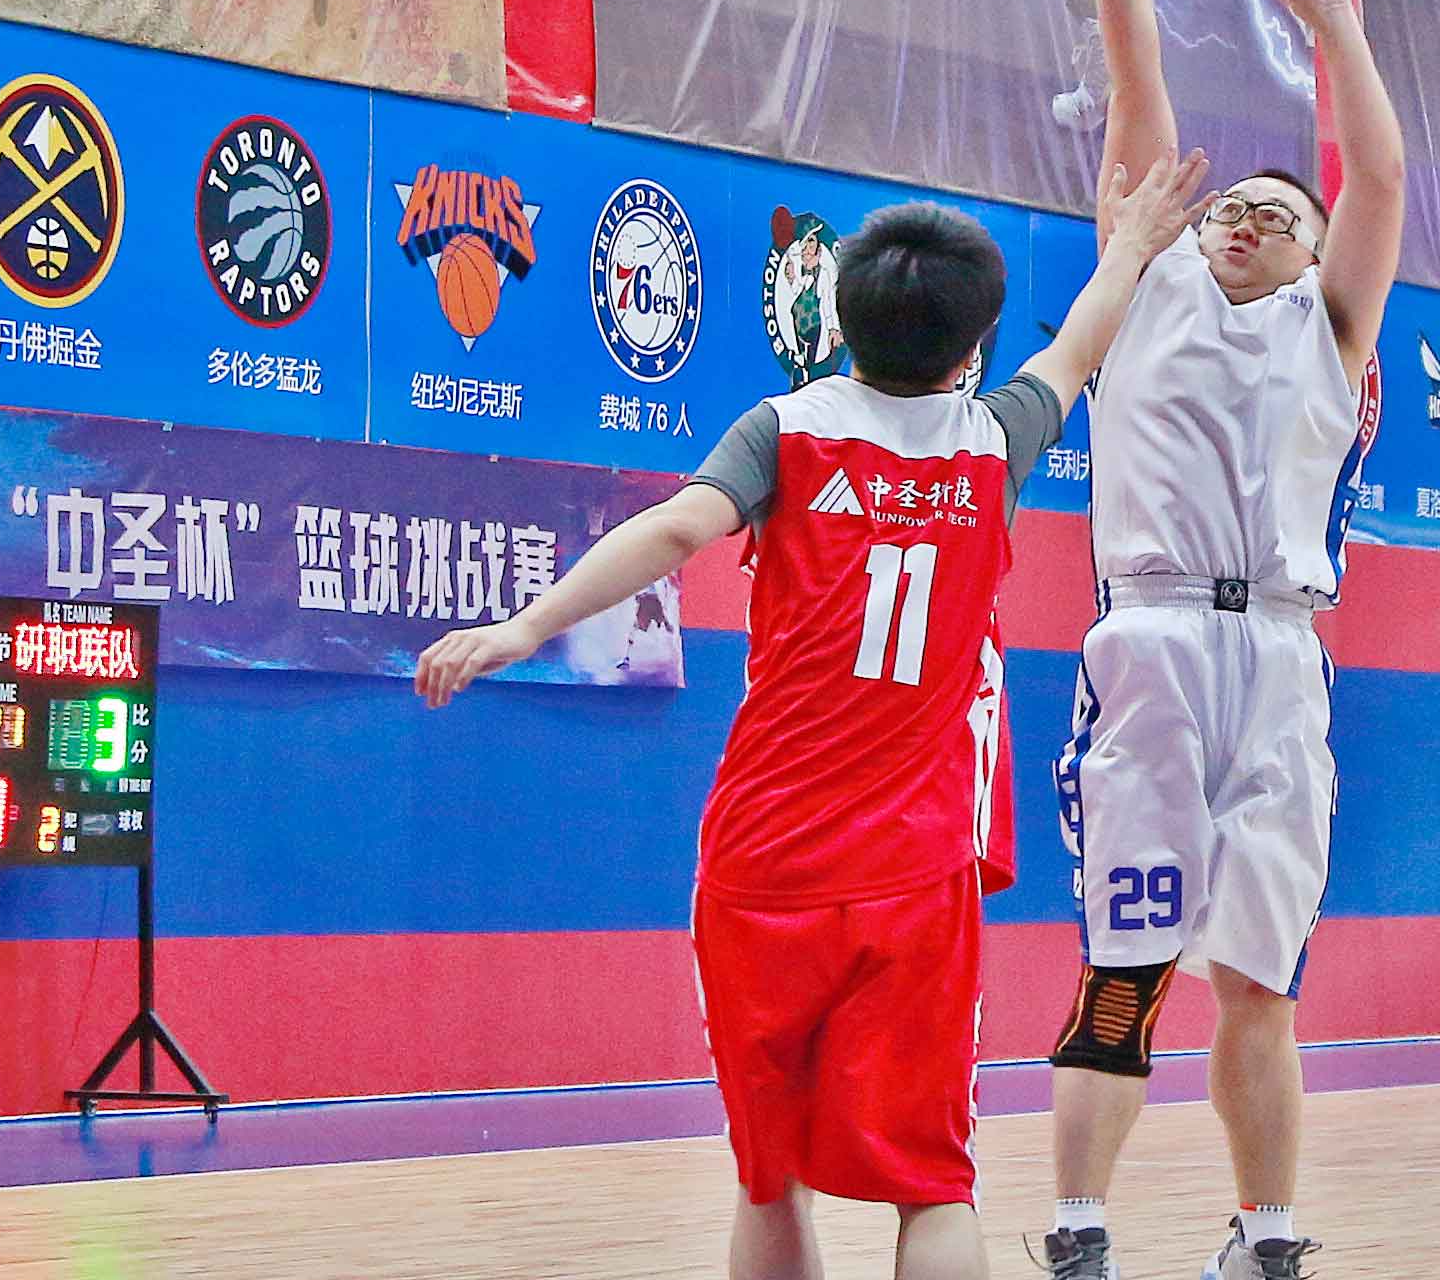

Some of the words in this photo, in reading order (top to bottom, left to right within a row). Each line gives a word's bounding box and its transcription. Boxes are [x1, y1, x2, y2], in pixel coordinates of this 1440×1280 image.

[208, 128, 321, 207] TORONTO
[397, 164, 537, 267] KNICKS
[594, 188, 697, 286] PHILADELPHIA
[208, 239, 320, 317] RAPTORS
[616, 262, 679, 317] 76ers
[763, 249, 785, 357] BOSTON
[207, 347, 322, 395] 多伦多猛龙
[410, 371, 524, 420] 纽约尼克斯
[599, 393, 641, 432] 费城
[646, 402, 669, 433] 76
[672, 403, 693, 438] 人
[294, 503, 558, 623] 篮球挑战赛
[62, 604, 86, 624] TEAM
[87, 605, 113, 625] NAME
[853, 542, 939, 687] 11
[14, 622, 139, 679] 研职联队
[37, 805, 60, 853] 2
[1108, 865, 1183, 931] 29
